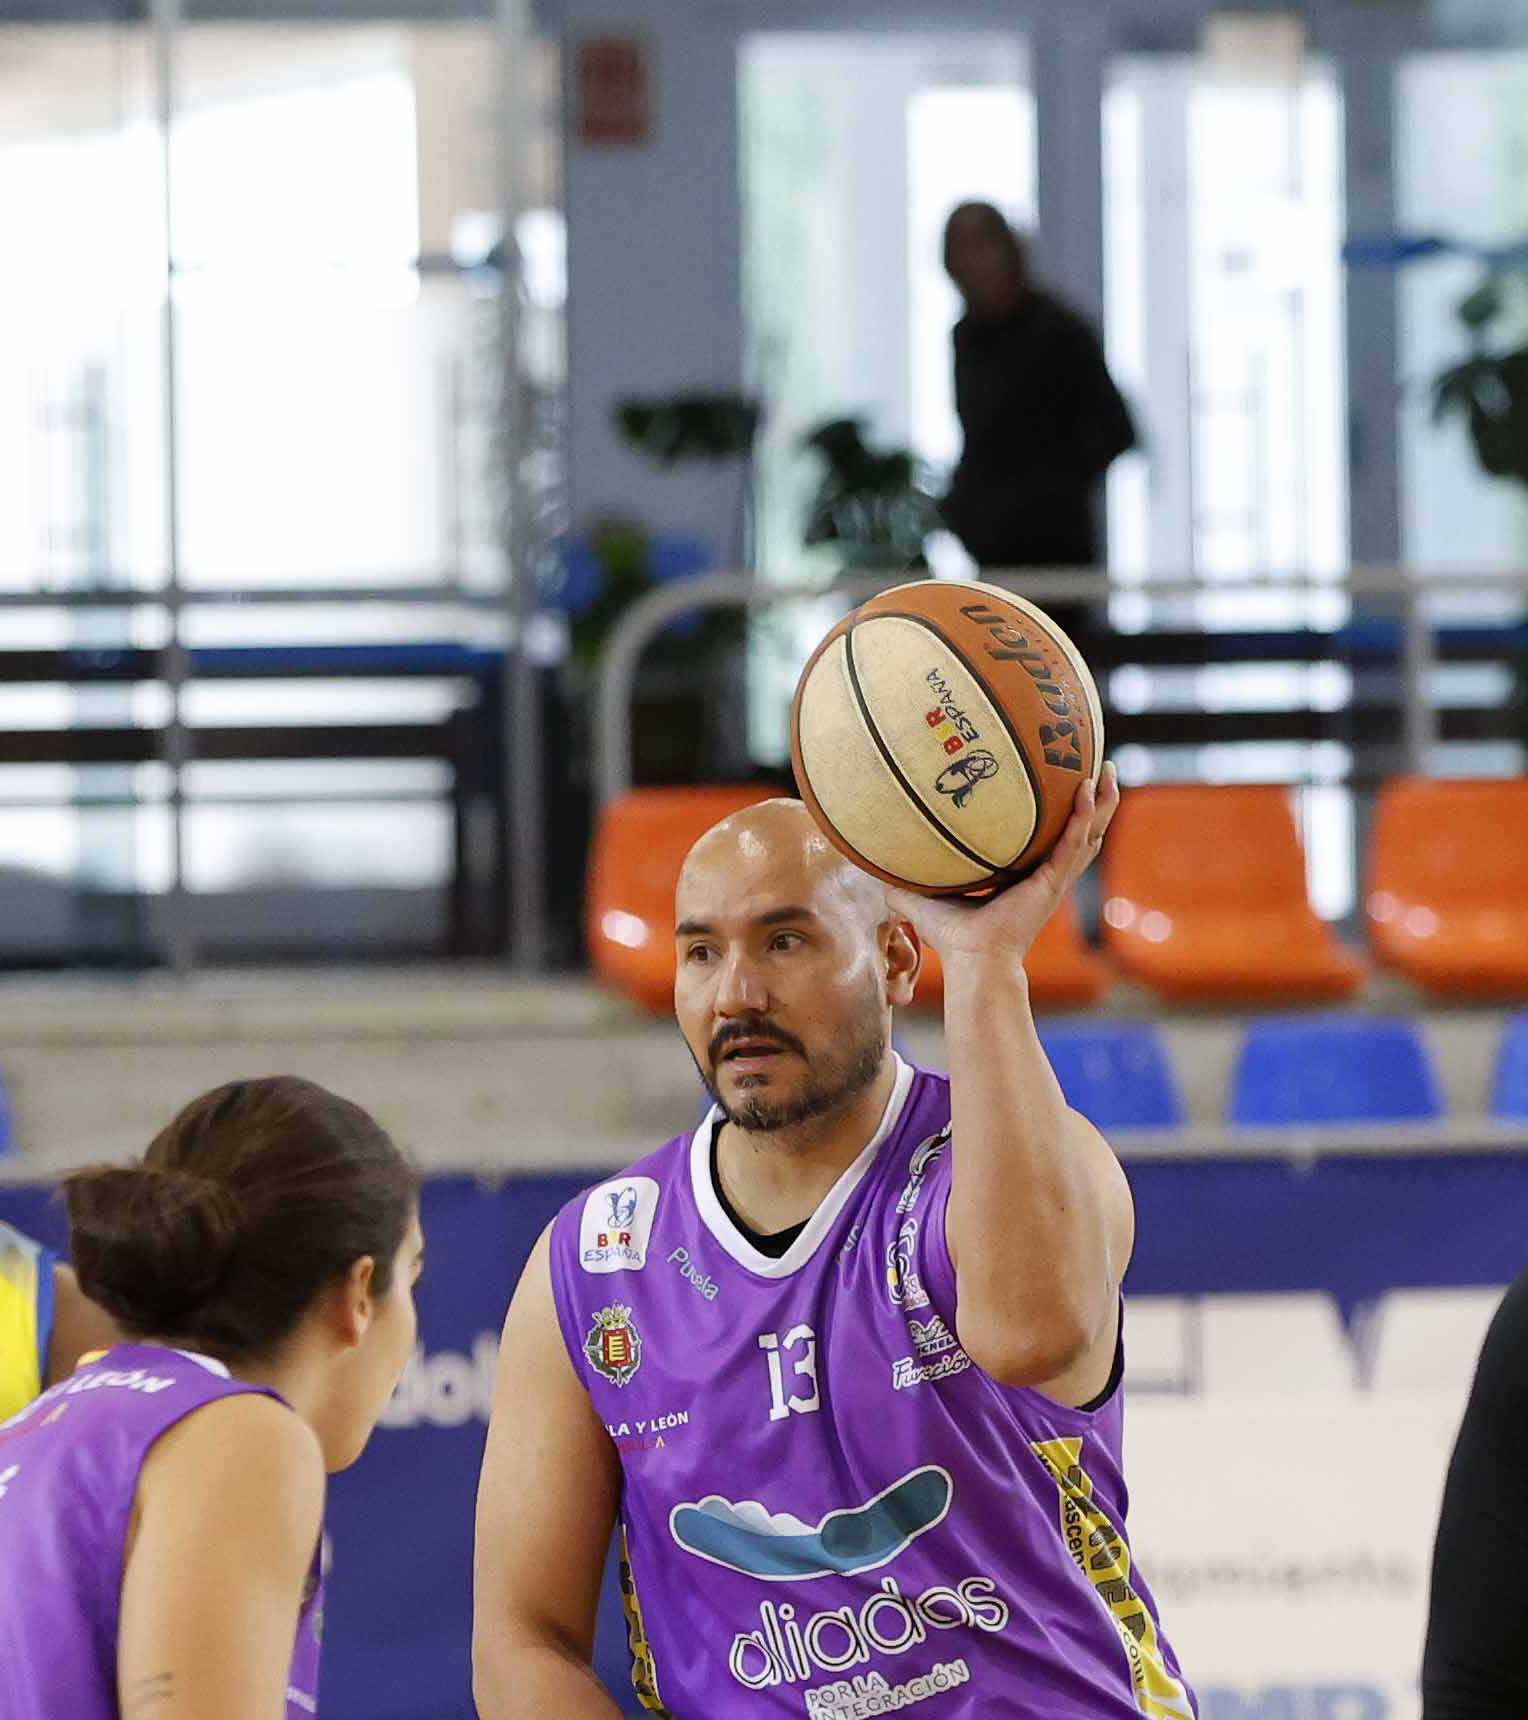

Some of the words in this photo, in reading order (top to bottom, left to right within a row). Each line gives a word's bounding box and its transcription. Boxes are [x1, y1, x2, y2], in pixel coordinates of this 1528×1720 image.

[960, 604, 1082, 772] Baden
[758, 1323, 819, 1421] 13
[605, 1422, 631, 1437] LA
[635, 1421, 647, 1434] Y
[650, 1410, 690, 1433] LEÓN
[729, 1576, 1009, 1690] aliados
[805, 1682, 853, 1709] POR
[852, 1672, 889, 1699] LA
